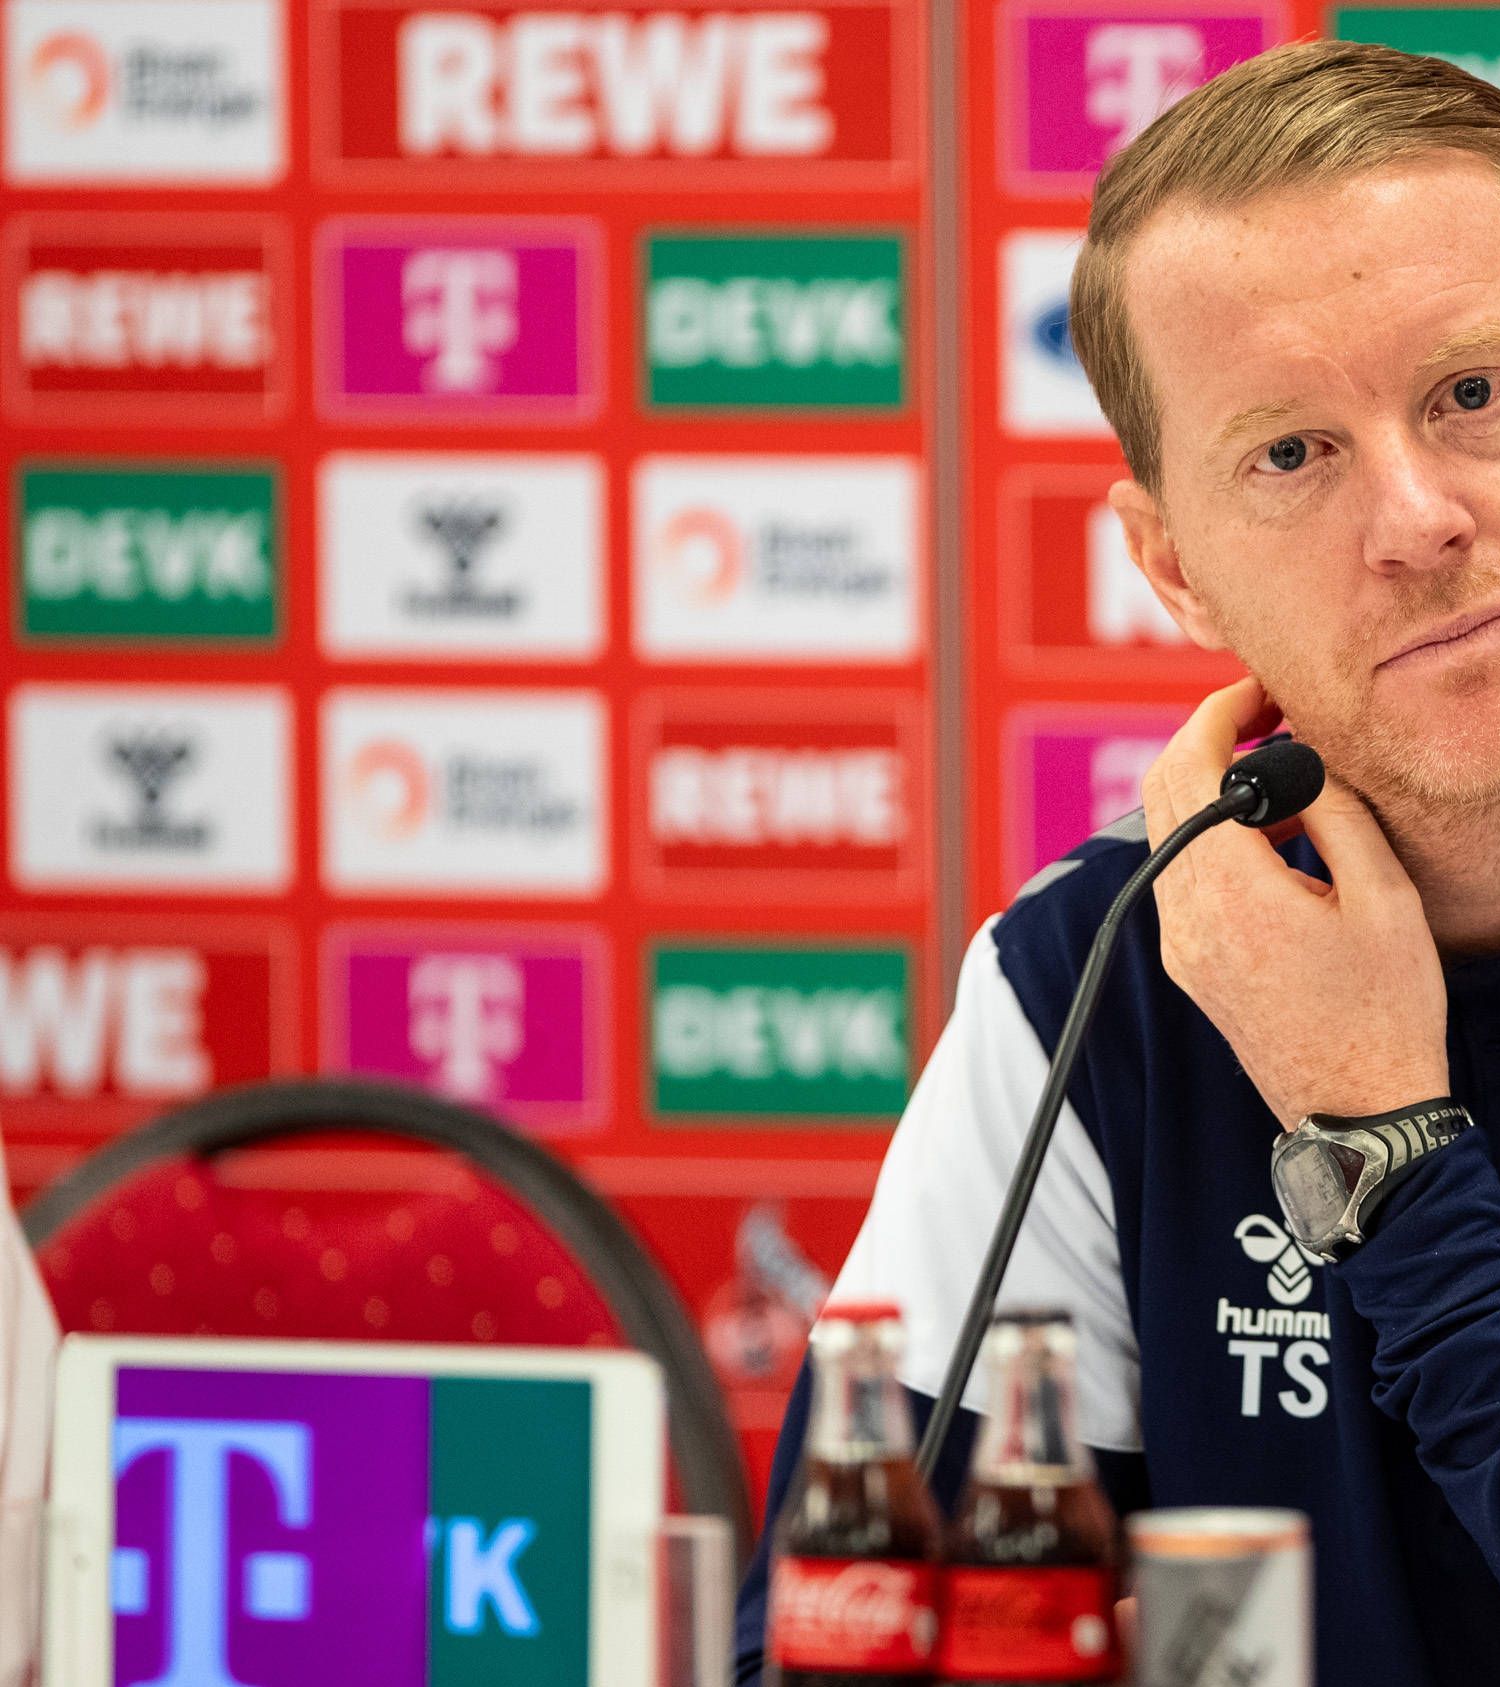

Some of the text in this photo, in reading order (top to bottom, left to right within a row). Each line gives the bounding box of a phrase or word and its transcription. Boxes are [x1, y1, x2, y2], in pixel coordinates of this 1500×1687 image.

[401, 12, 831, 156] REWE
[21, 273, 268, 366] REWE
[648, 275, 898, 368] DEVK
[24, 508, 271, 601] DEVK
[652, 749, 903, 843] REWE
[655, 985, 904, 1081] DEVK
[1228, 1340, 1331, 1419] TS
[425, 1515, 541, 1636] K
